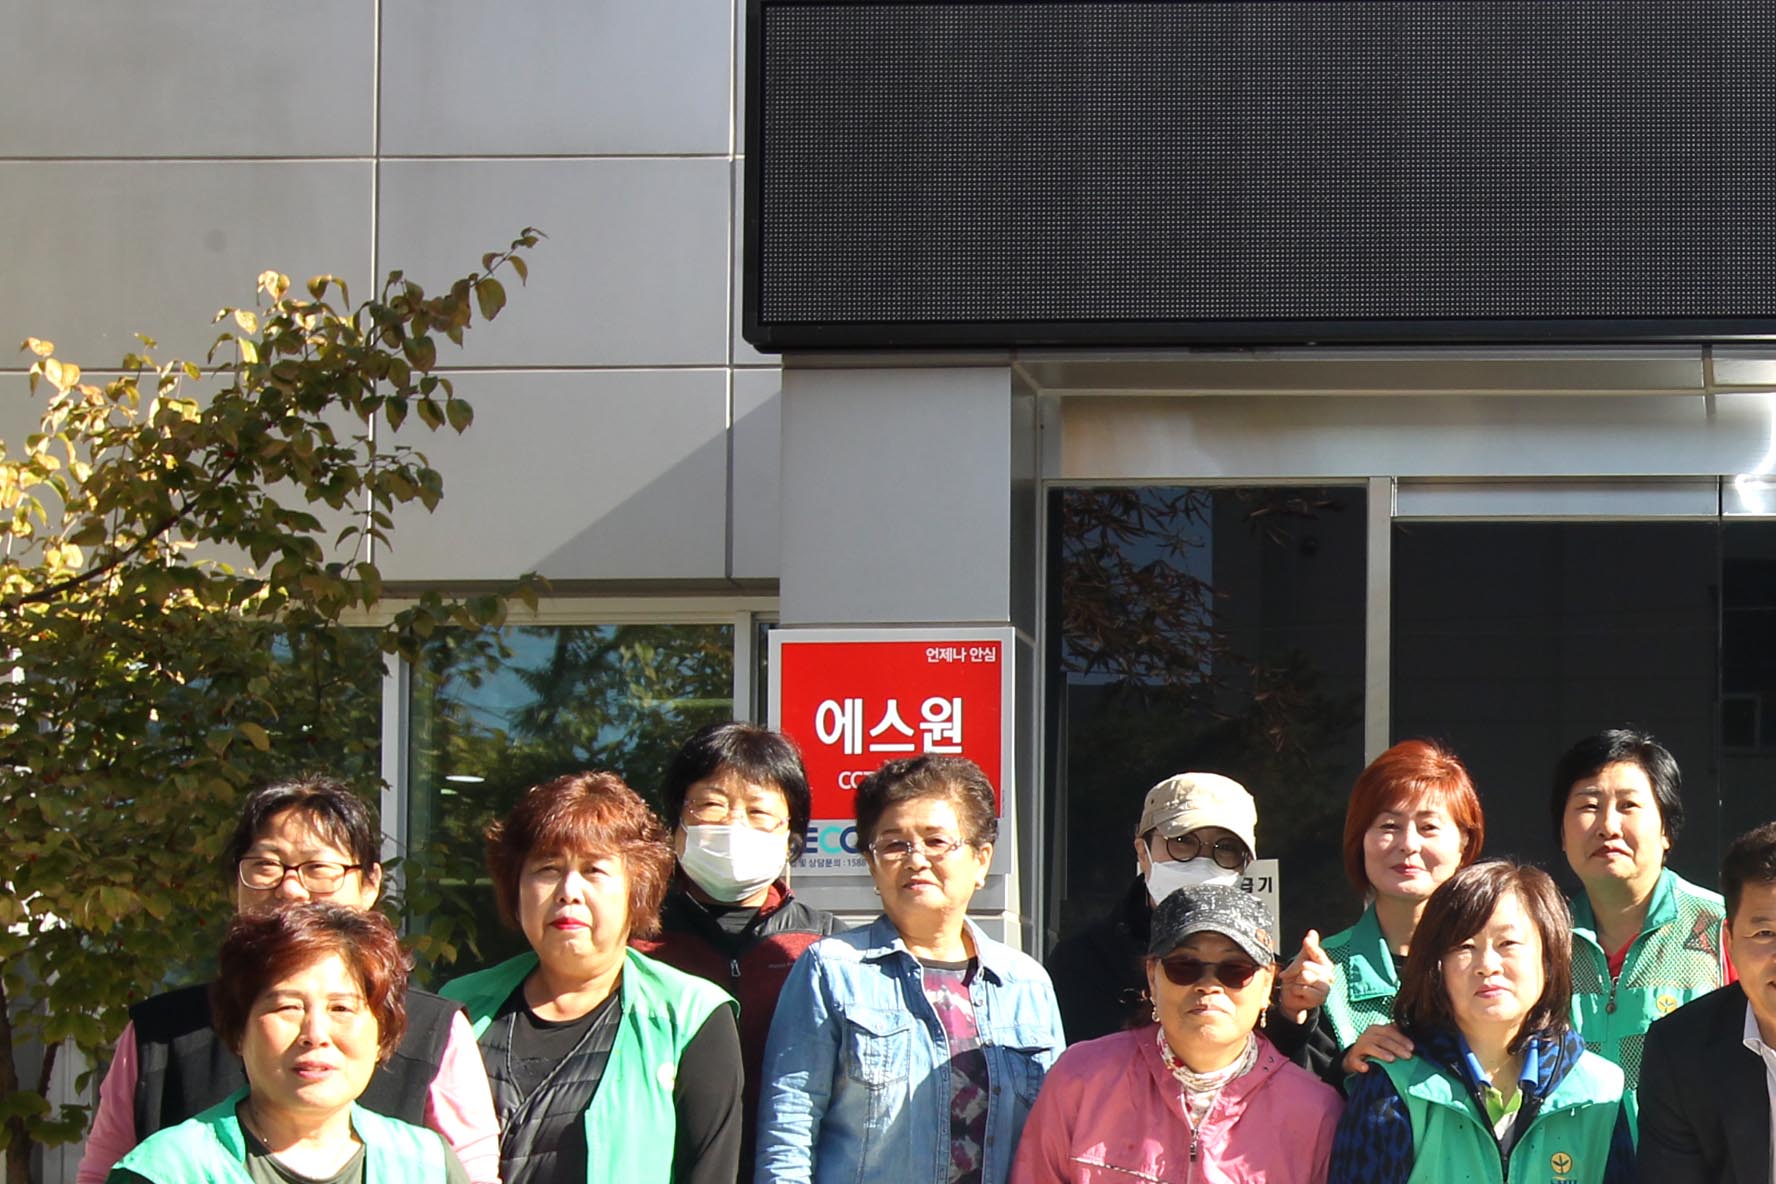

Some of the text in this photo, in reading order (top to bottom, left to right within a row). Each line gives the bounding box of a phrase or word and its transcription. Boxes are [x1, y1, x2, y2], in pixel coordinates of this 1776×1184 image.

[926, 646, 997, 663] 언제나 안심
[815, 696, 963, 755] 에스원
